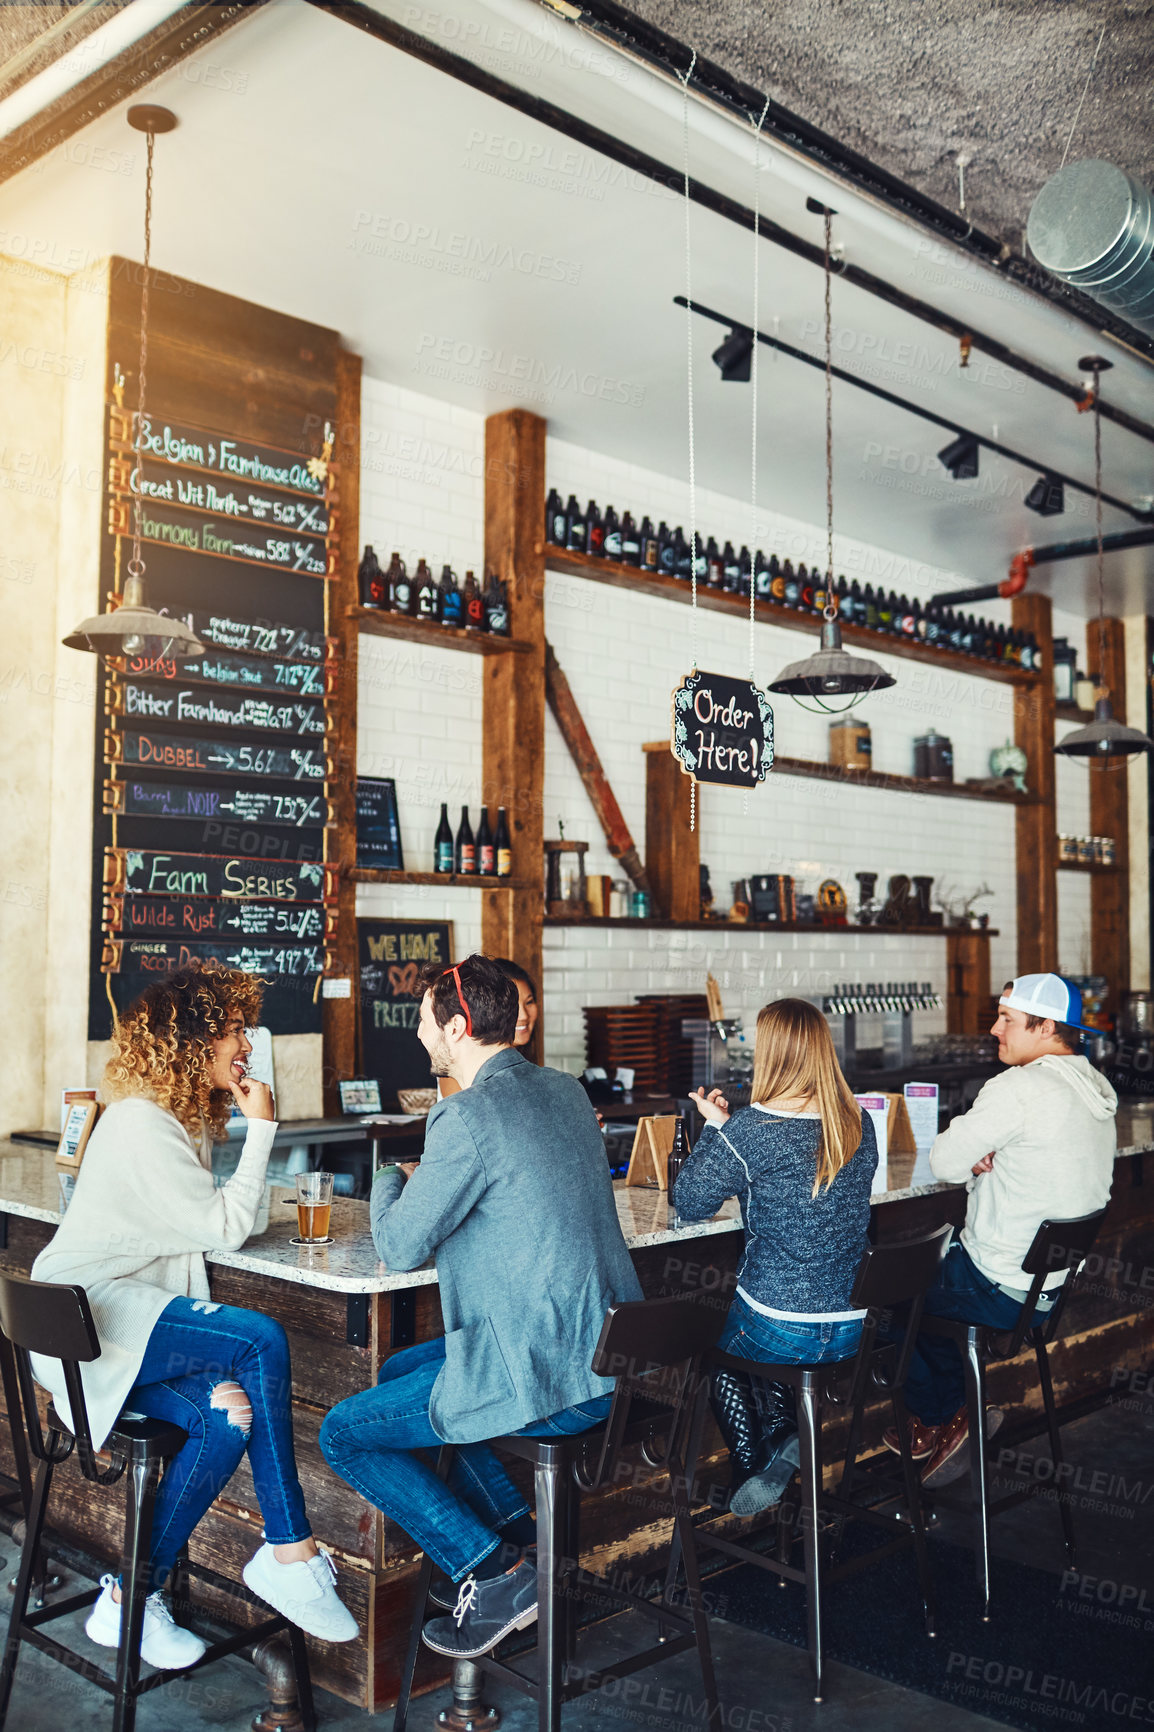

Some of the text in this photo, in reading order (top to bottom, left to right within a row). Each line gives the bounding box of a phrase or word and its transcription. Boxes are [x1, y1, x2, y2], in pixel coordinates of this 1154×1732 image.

[134, 420, 205, 464] Belgian
[219, 440, 289, 485] Farmhouse
[129, 466, 240, 516] Great Wit North
[133, 508, 199, 551] Harmony
[202, 523, 234, 556] Farm
[202, 660, 239, 683] Belgian
[126, 686, 173, 717] Bitter
[177, 691, 246, 726] Farmhand
[694, 689, 754, 730] Order
[138, 735, 207, 769] DUBBEL
[238, 747, 276, 774] 5.6%
[694, 729, 759, 778] Here!
[186, 791, 221, 817] NOIR
[149, 856, 208, 895] Farm
[131, 903, 176, 927] Wilde
[129, 942, 168, 954] GINGER
[140, 954, 177, 973] ROOT
[367, 931, 442, 963] WE HAVE
